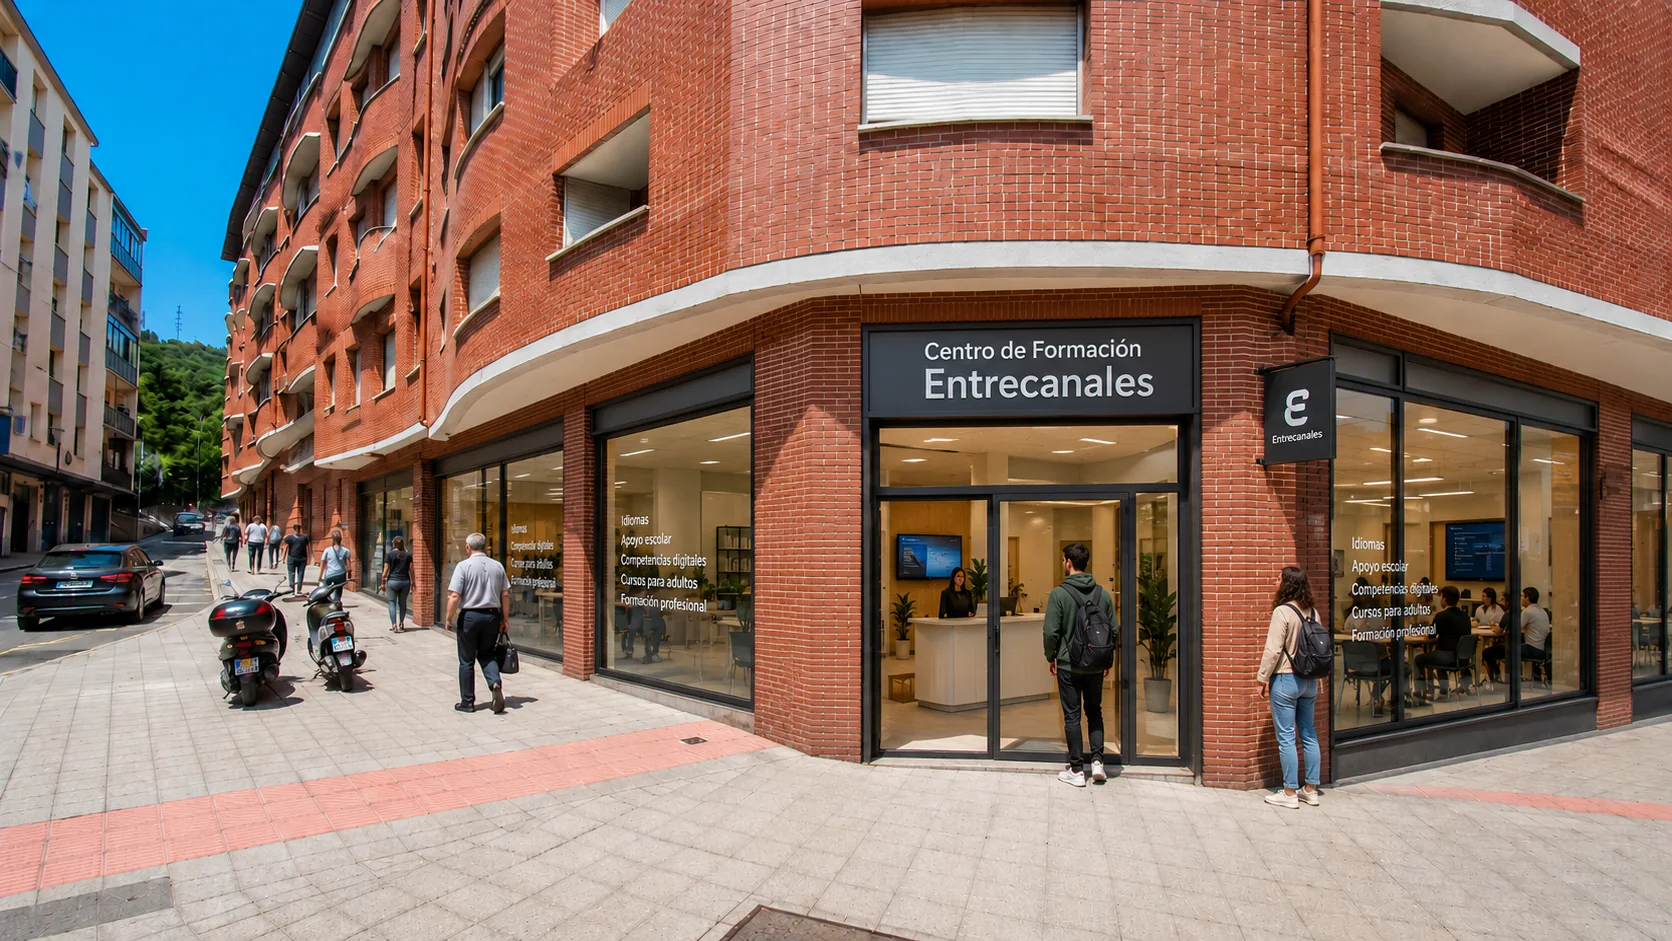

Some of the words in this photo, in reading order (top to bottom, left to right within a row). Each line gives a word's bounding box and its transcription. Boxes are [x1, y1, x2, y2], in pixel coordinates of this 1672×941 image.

[924, 342, 995, 360] Centro
[1001, 340, 1026, 359] de
[1033, 339, 1141, 359] Formación
[925, 365, 1154, 399] Entrecanales
[1272, 430, 1323, 444] Entrecanales
[621, 515, 649, 526] Idiomas
[621, 534, 643, 548] Apoyo
[645, 532, 672, 545] escolar
[1351, 536, 1385, 550] Idiomas
[621, 553, 671, 568] Competencias
[672, 553, 707, 569] digitales
[1351, 560, 1380, 575] Apoyo
[1381, 559, 1409, 572] escolar
[621, 574, 646, 586] Cursos
[647, 577, 665, 589] para
[666, 575, 698, 589] adultos
[1351, 582, 1408, 598] Competencias
[1409, 582, 1438, 597] digitales
[621, 593, 659, 607] Formación
[660, 597, 707, 612] profesional
[1351, 606, 1382, 619] Cursos
[1384, 606, 1402, 620] para
[1403, 603, 1431, 616] adultos
[1351, 627, 1395, 642] Formación
[1396, 623, 1437, 641] profesional
